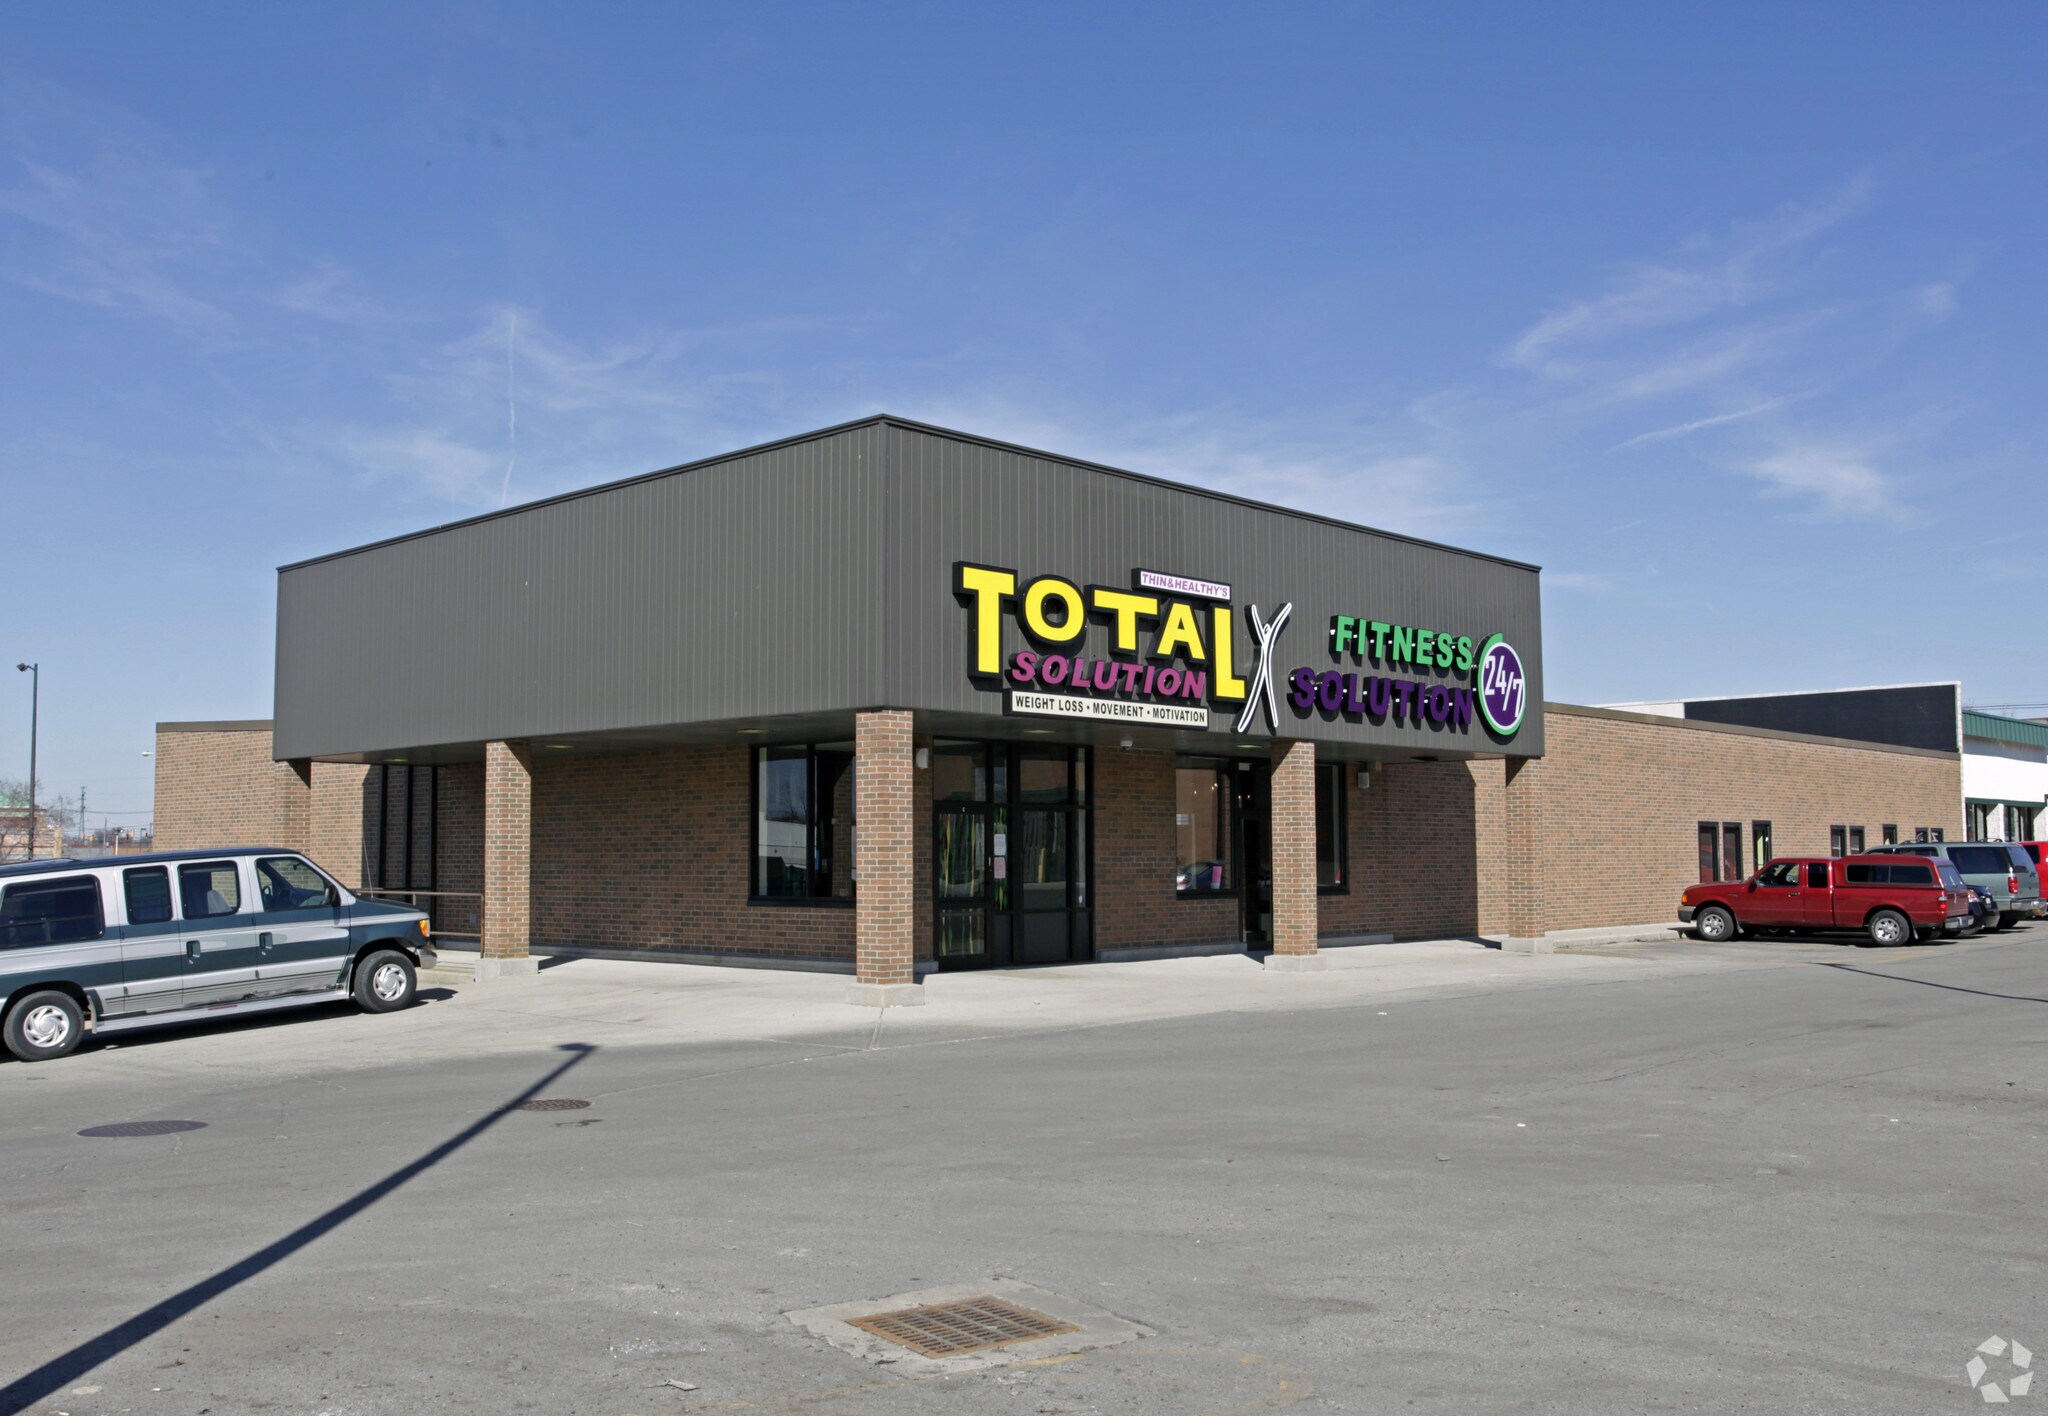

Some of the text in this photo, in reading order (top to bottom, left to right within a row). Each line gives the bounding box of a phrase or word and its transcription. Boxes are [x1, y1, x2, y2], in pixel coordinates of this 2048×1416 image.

[1142, 573, 1228, 597] THIN&HEALTHY'S
[962, 566, 1246, 699] TOTAL
[1335, 615, 1473, 671] FITNESS
[1012, 651, 1206, 698] SOLUTION
[1293, 667, 1473, 725] SOLUTION
[1484, 655, 1524, 718] 24/7
[1015, 695, 1205, 723] WEIGHT LOSS MOVEMENT MOTIVATION
